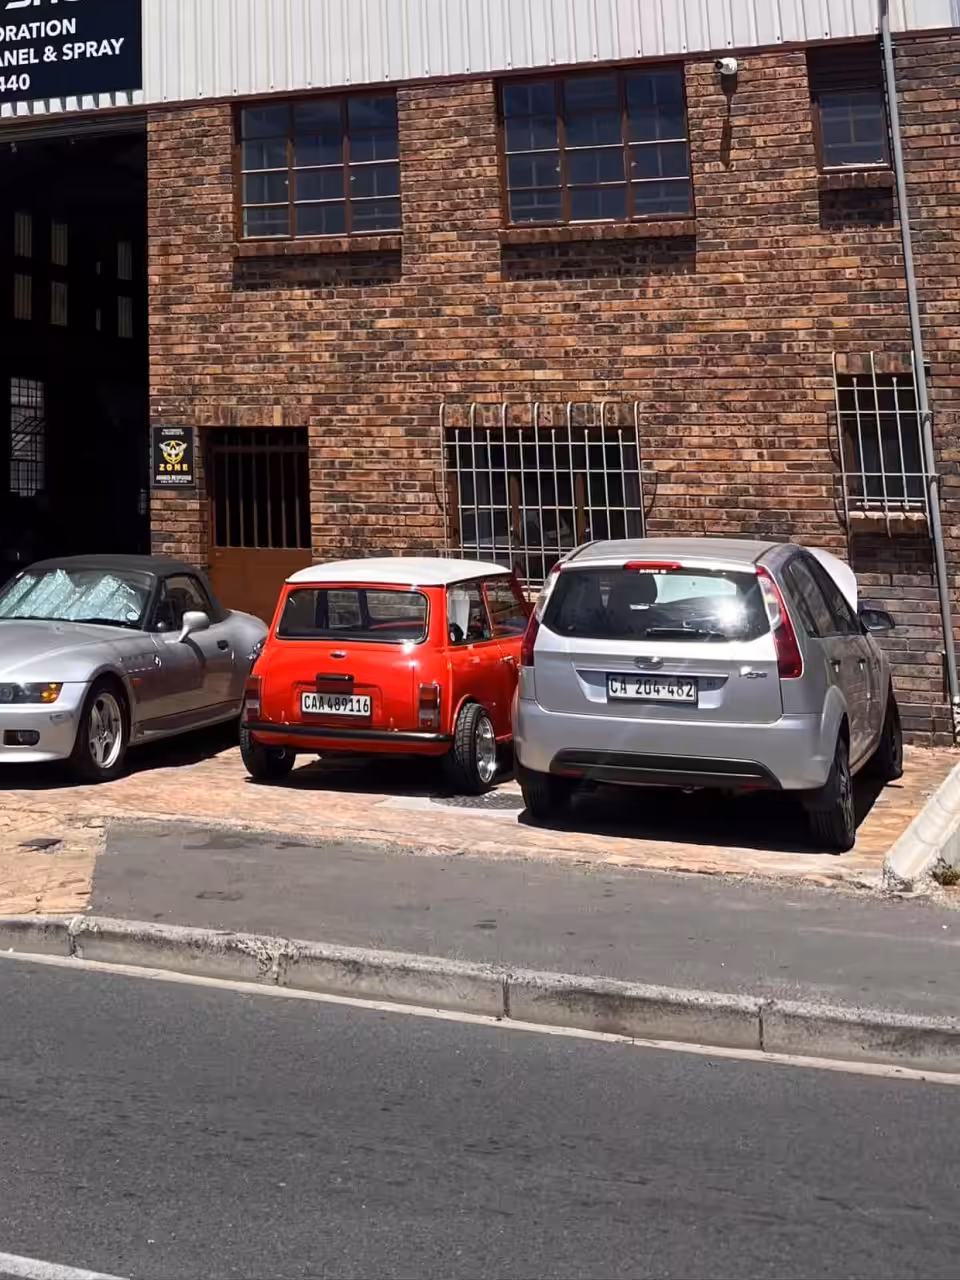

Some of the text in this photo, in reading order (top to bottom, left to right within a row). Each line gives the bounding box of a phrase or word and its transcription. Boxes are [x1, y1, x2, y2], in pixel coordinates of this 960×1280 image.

[43, 46, 58, 62] &
[62, 38, 124, 60] SPRAY
[159, 463, 188, 471] ZONE
[610, 677, 694, 698] CA 204-482
